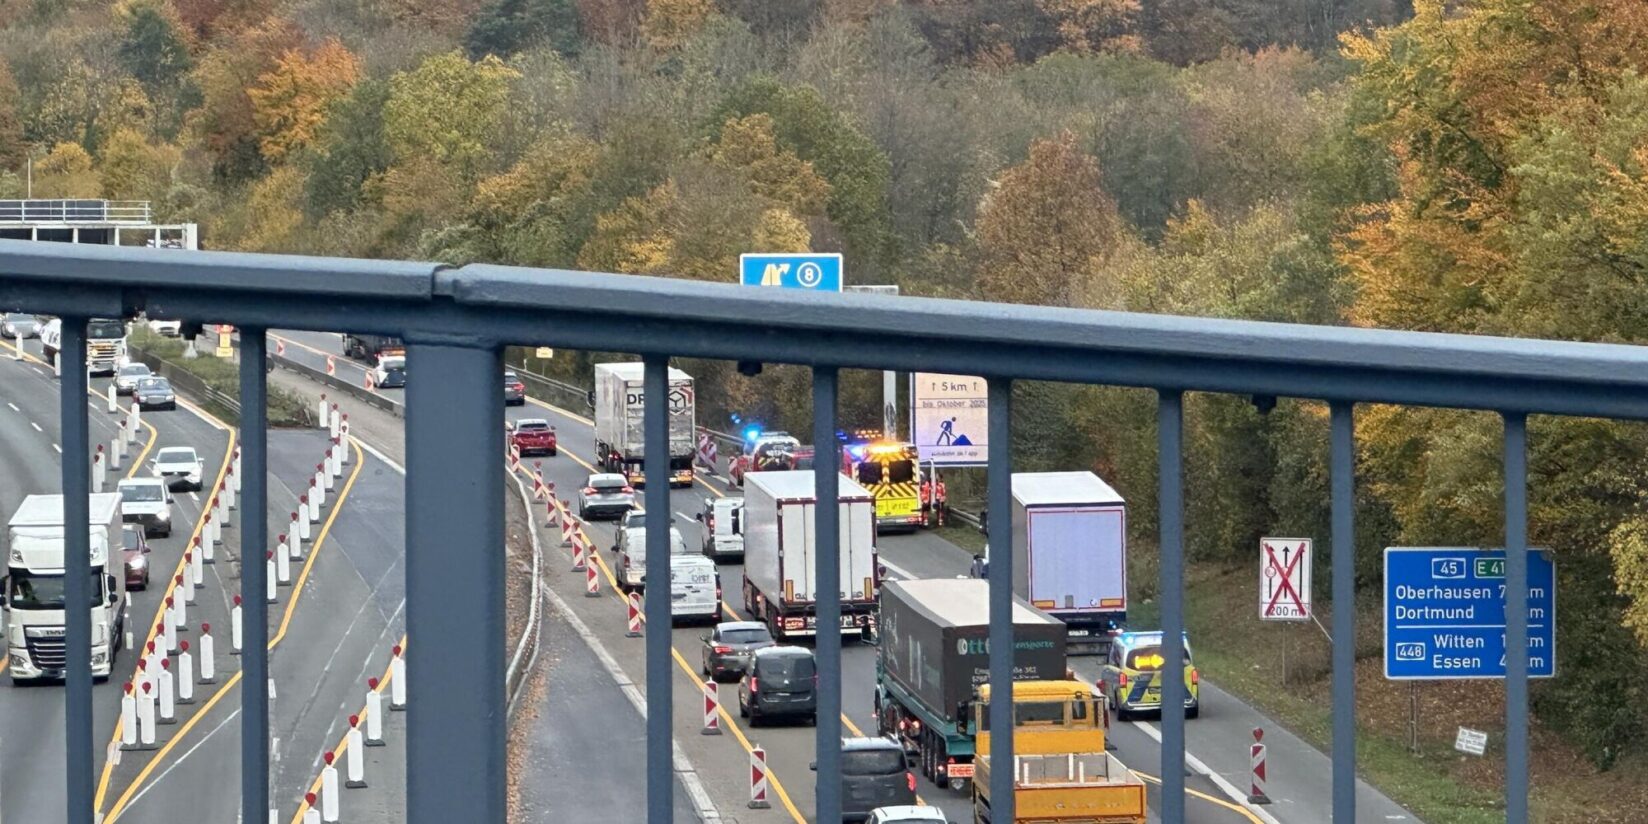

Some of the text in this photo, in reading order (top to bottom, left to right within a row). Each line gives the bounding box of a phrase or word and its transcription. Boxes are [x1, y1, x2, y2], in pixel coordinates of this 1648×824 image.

[804, 267, 814, 281] 8
[942, 381, 967, 391] 5 km
[627, 393, 645, 405] DP
[922, 400, 933, 408] bis
[937, 400, 965, 408] Oktober
[1440, 562, 1457, 575] 45
[1477, 562, 1487, 575] E
[1395, 585, 1491, 599] Oberhausen
[1268, 606, 1301, 616] 200 m
[1396, 605, 1474, 619] Dortmund
[1434, 634, 1485, 648] Witten
[1400, 646, 1422, 657] 448
[1433, 655, 1481, 669] Essen
